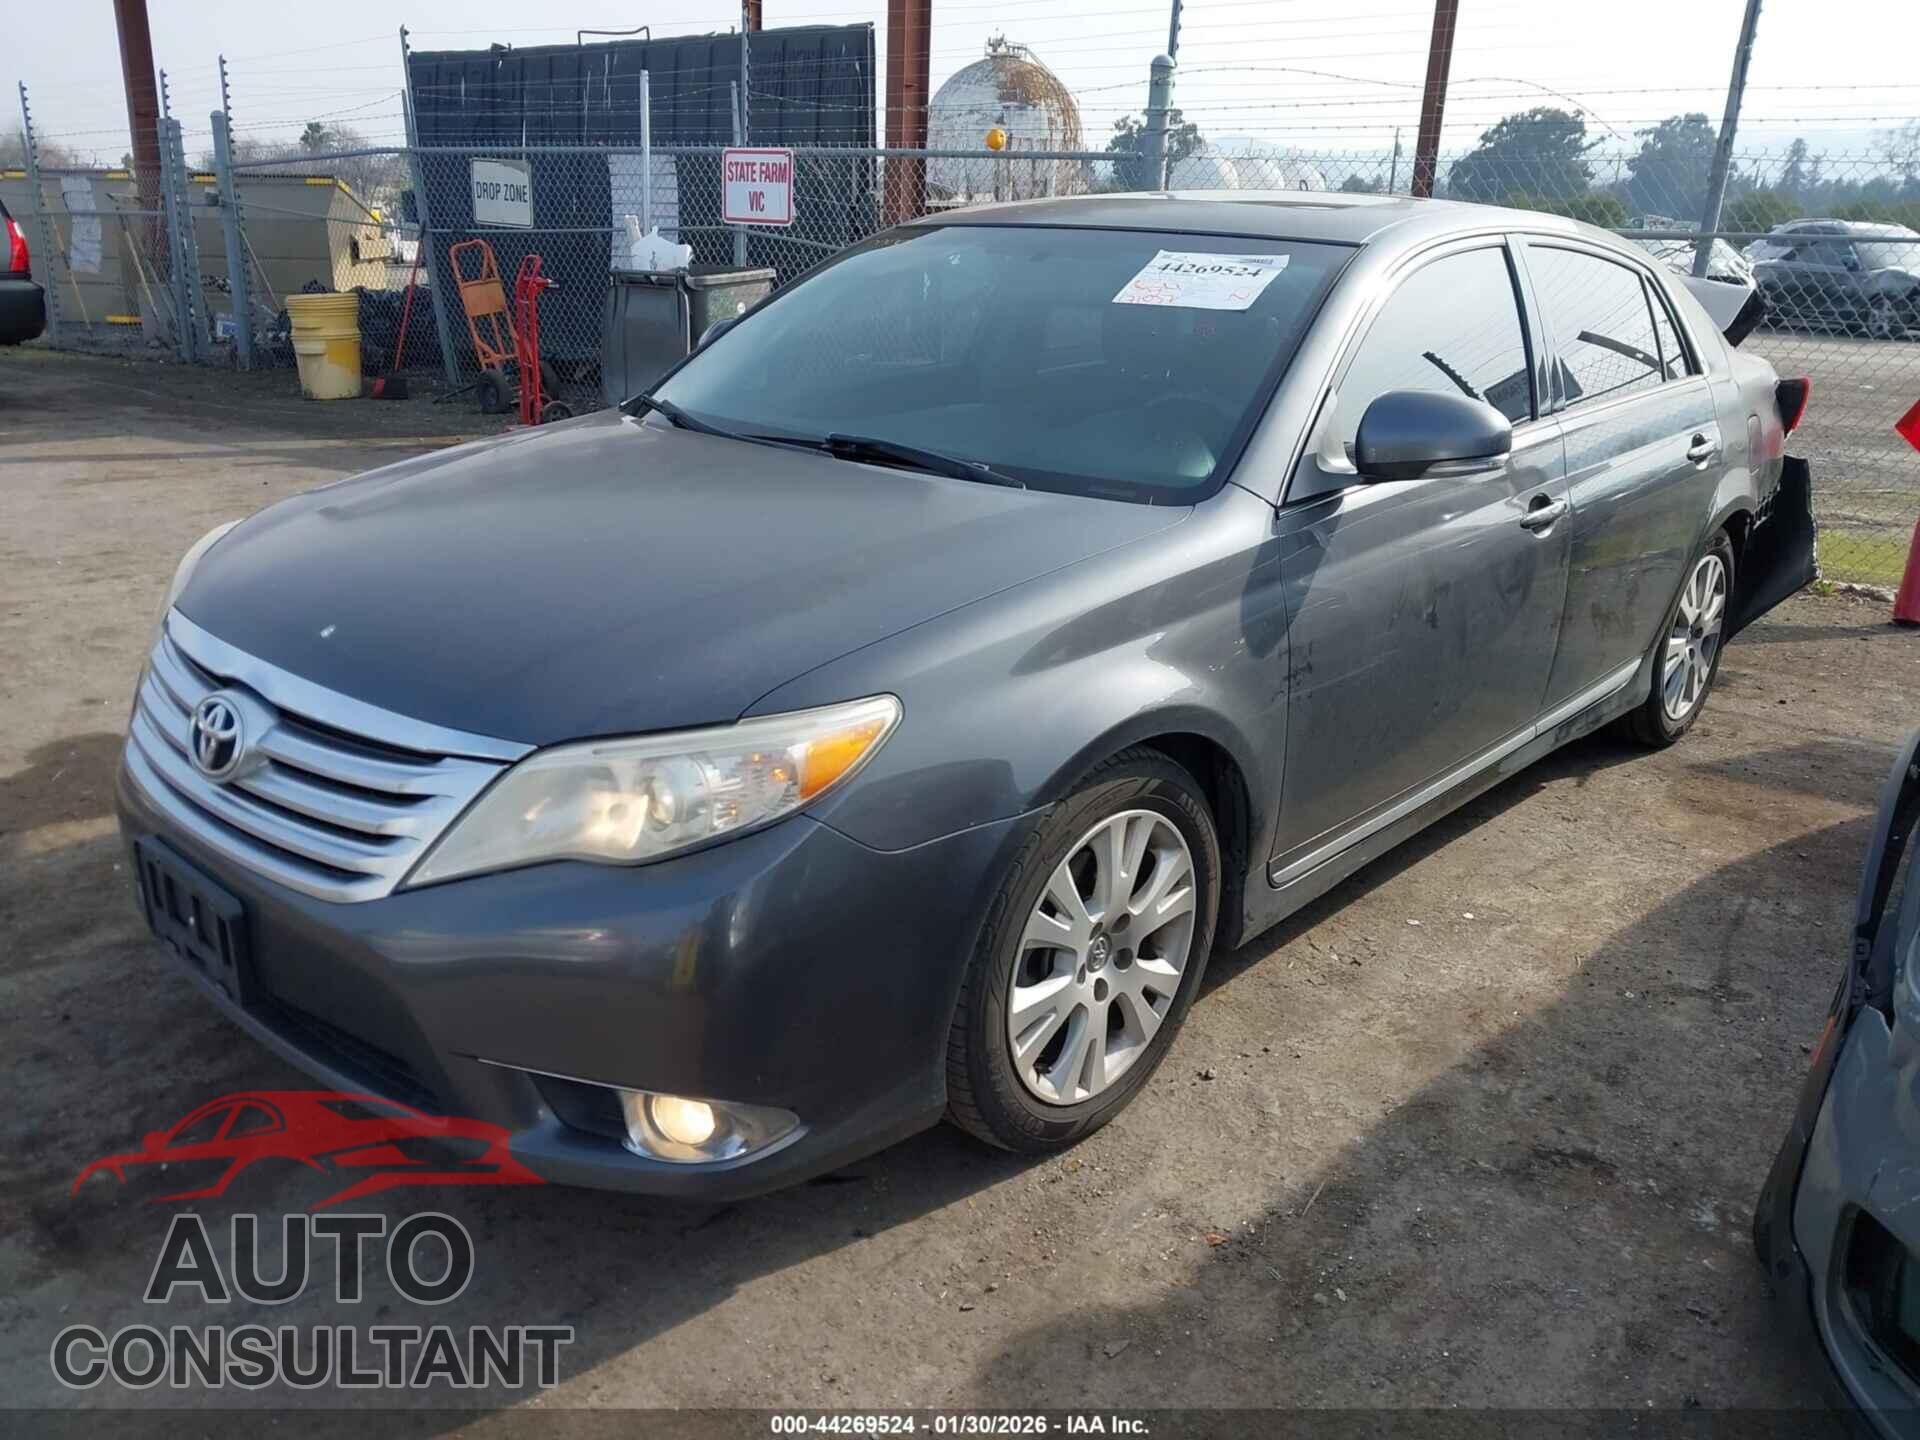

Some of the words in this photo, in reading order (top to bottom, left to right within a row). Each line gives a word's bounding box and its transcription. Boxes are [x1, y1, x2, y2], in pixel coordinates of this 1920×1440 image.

[728, 161, 757, 182] STATE
[760, 162, 788, 183] FARM
[476, 182, 501, 200] DROP
[504, 184, 528, 203] ZONE
[749, 191, 765, 212] VIC
[1157, 262, 1262, 277] 44269524
